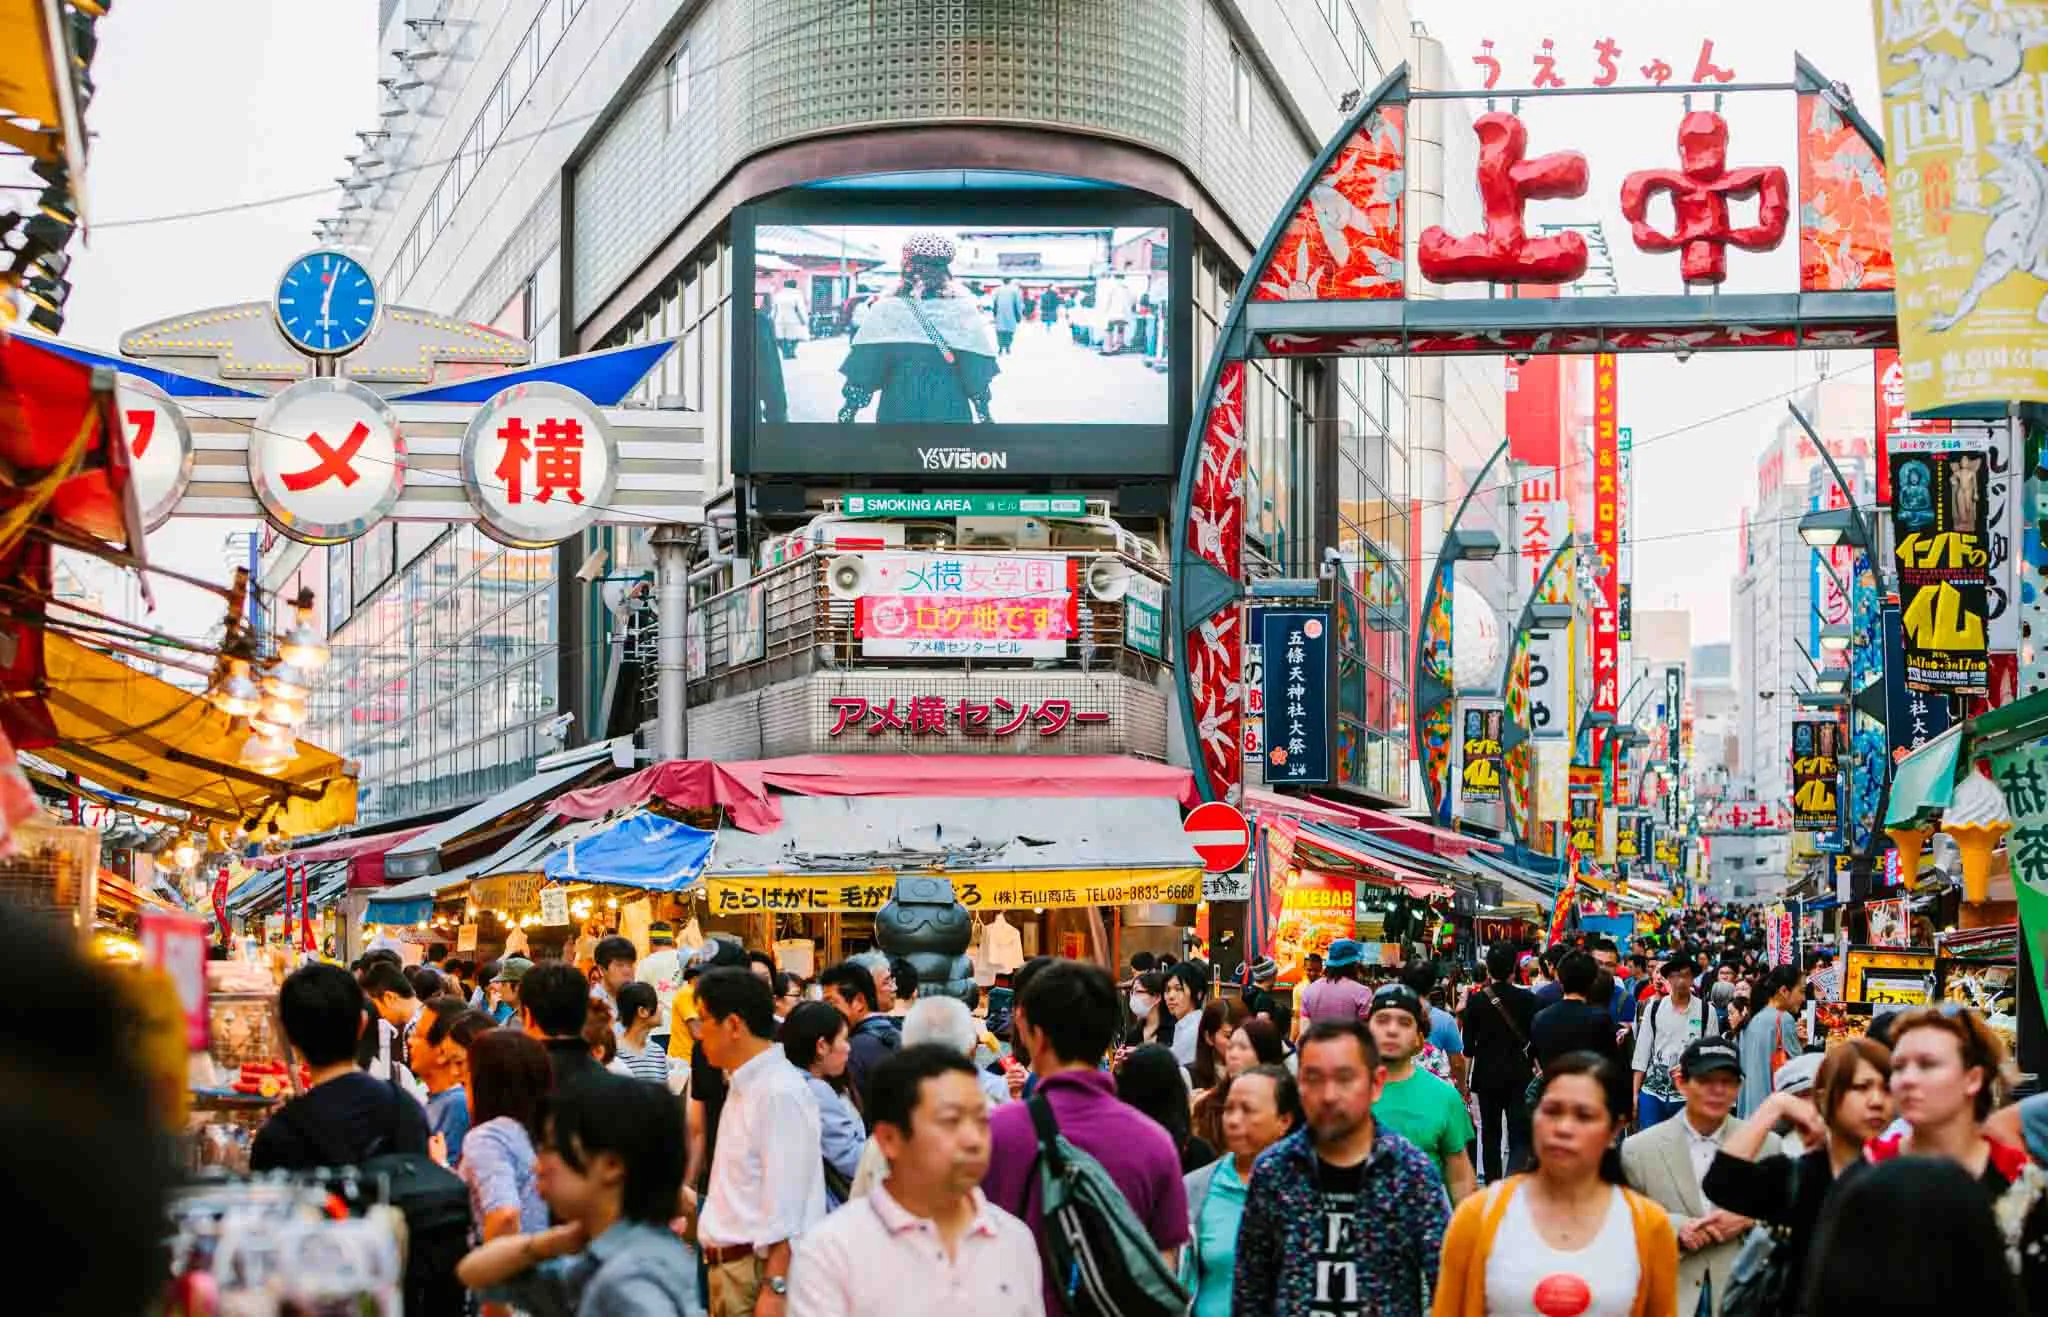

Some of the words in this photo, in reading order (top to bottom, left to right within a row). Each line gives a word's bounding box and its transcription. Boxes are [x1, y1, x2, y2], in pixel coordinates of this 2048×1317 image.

[1472, 38, 1736, 88] うえちゅん
[1418, 110, 1790, 286] 上中
[867, 499, 931, 512] SMOKING
[934, 499, 972, 512] AREA
[1895, 531, 1987, 569] インドの
[916, 606, 1054, 632] ロケ地です
[1903, 580, 1985, 650] 仏
[908, 641, 1022, 655] アメ横センタービル
[1286, 631, 1308, 756] 五條天神社大祭
[830, 694, 1110, 737] アメ横センター
[719, 887, 829, 910] たらばがに
[1299, 889, 1353, 907] KEBAB
